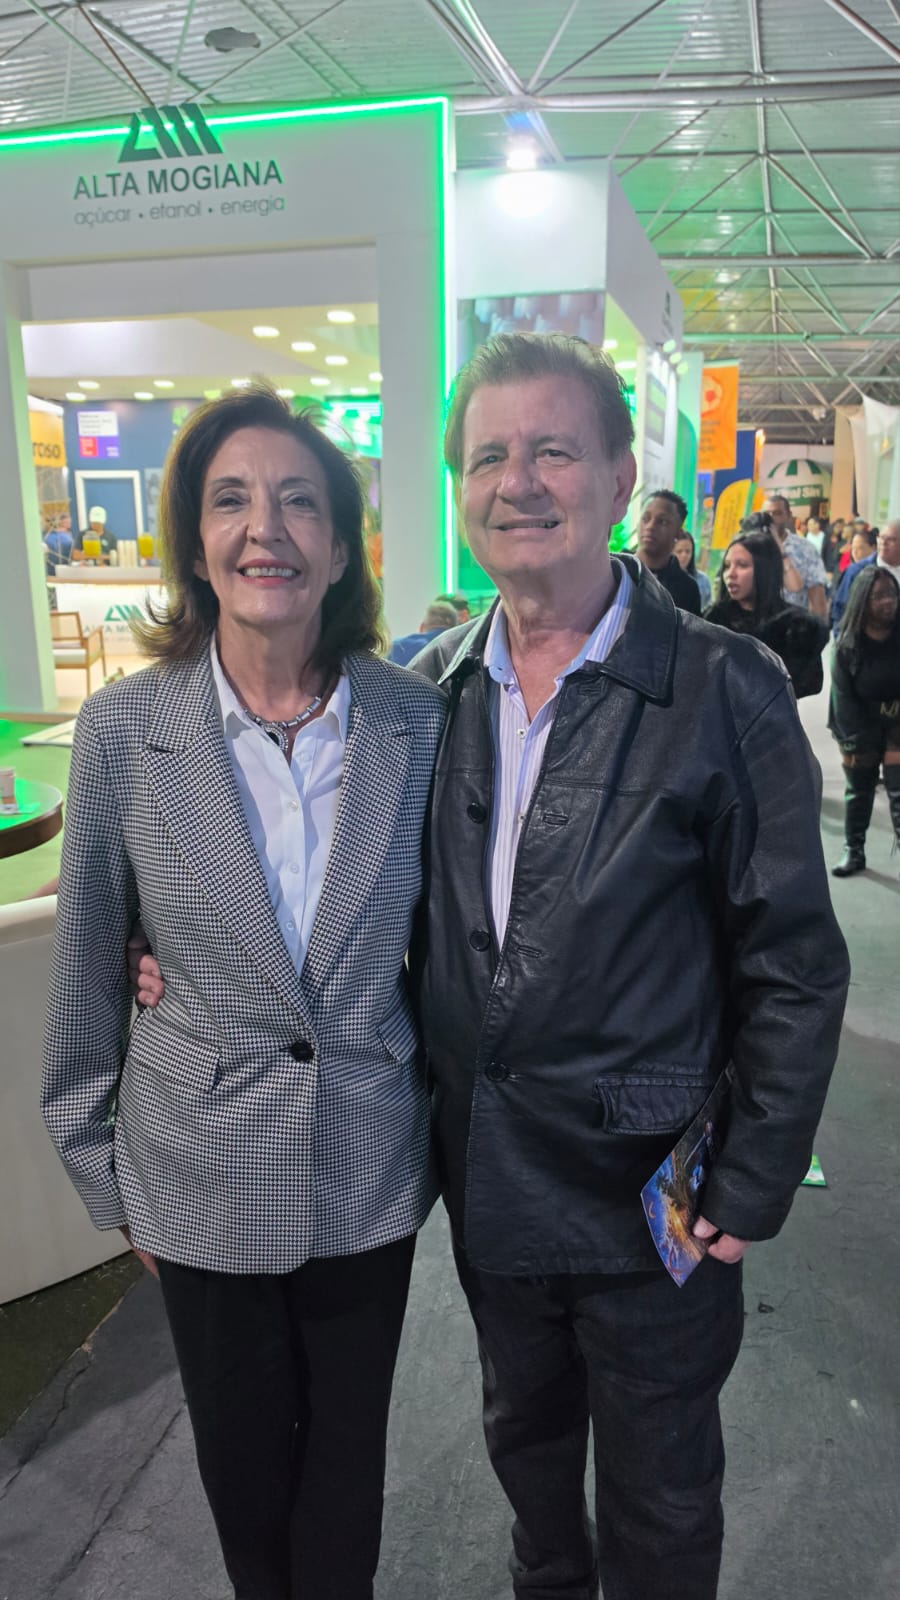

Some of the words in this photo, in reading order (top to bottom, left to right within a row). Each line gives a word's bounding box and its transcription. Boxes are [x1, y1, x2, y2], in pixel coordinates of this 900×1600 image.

[73, 171, 140, 200] ALTA
[147, 159, 284, 195] MOGIANA
[73, 205, 131, 229] açúcar
[149, 200, 202, 220] etanol
[220, 195, 286, 217] energia
